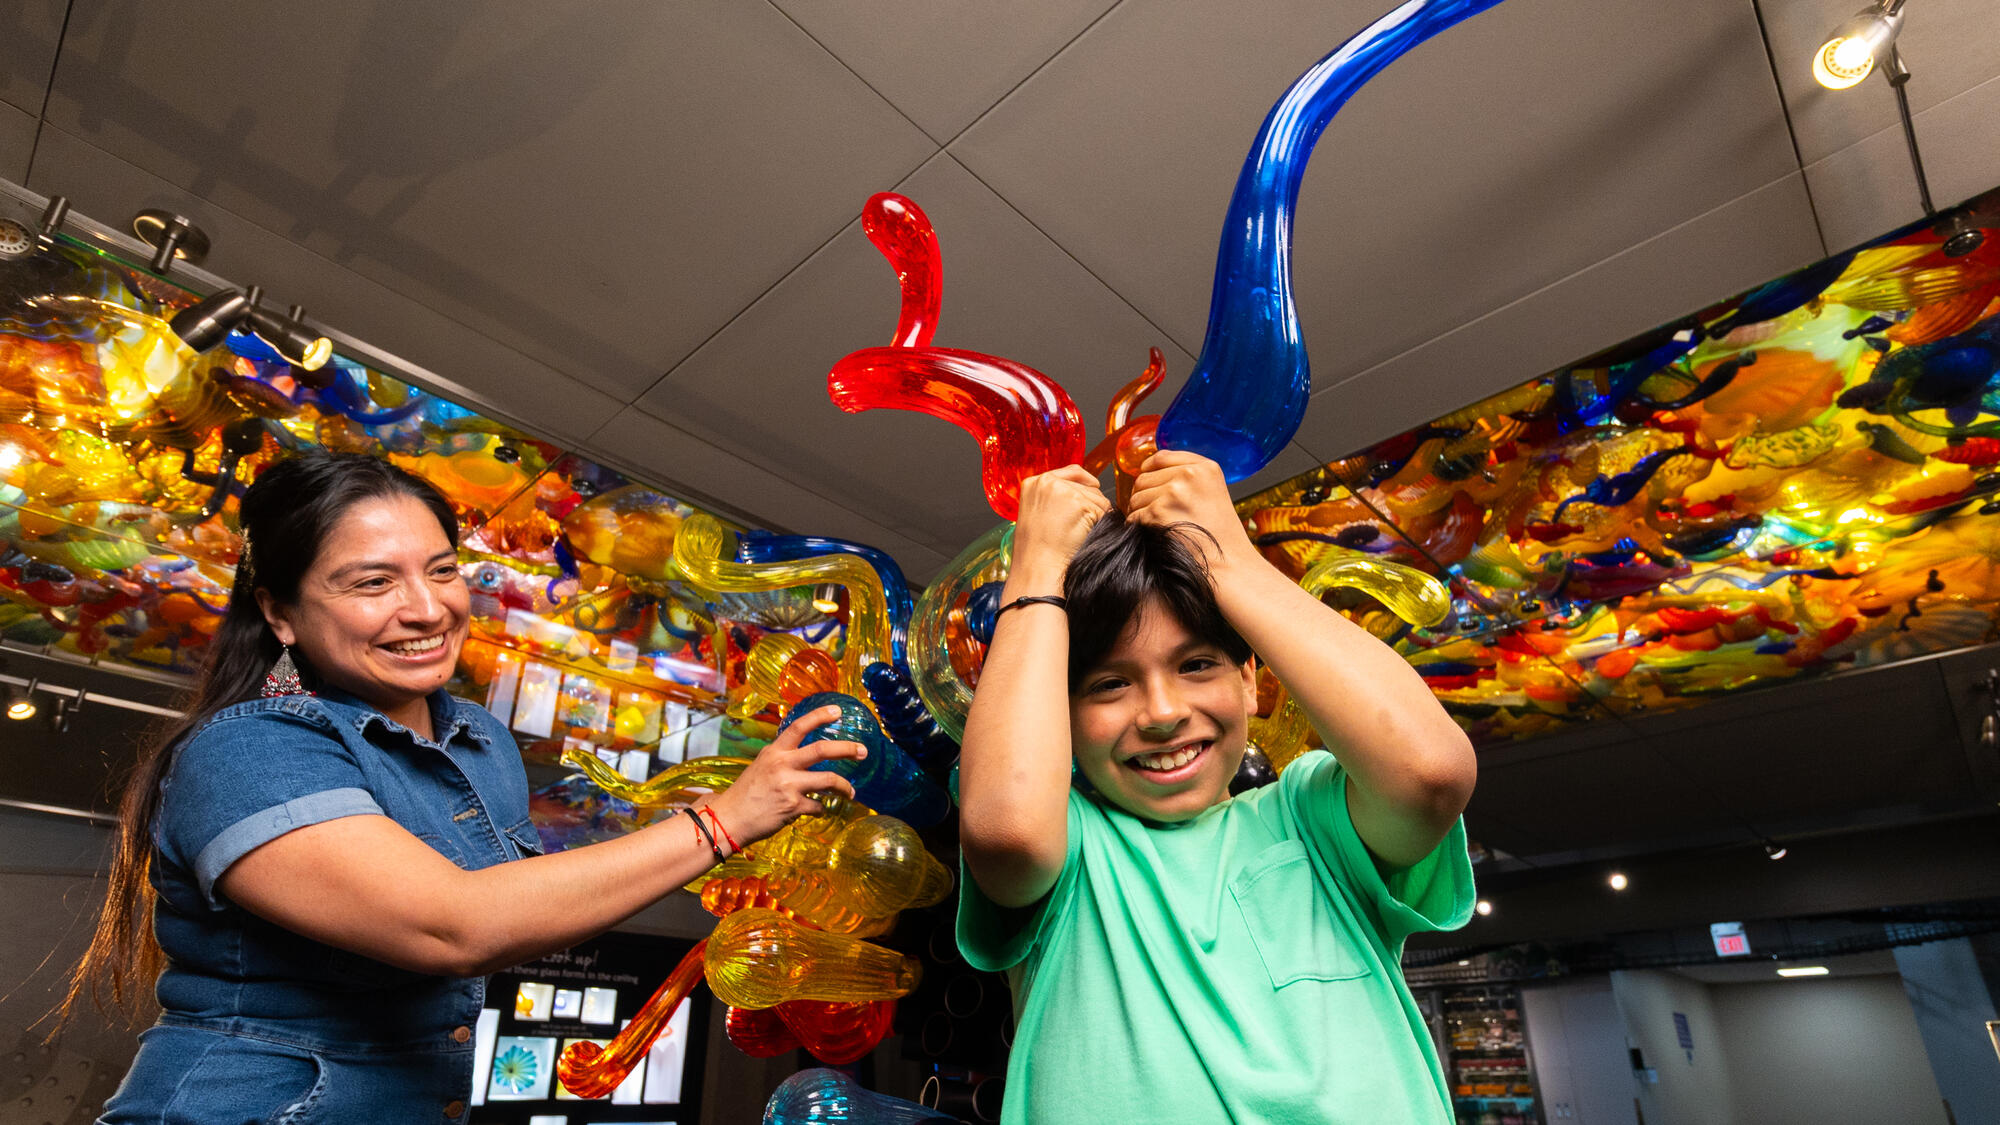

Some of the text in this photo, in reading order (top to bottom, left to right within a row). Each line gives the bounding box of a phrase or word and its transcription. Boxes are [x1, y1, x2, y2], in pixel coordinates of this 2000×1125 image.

[1720, 936, 1744, 954] EXIT
[575, 949, 599, 971] up!
[514, 966, 538, 976] these
[540, 968, 560, 978] glass
[561, 969, 586, 979] forms
[598, 972, 611, 981] the
[613, 974, 639, 985] ceiling
